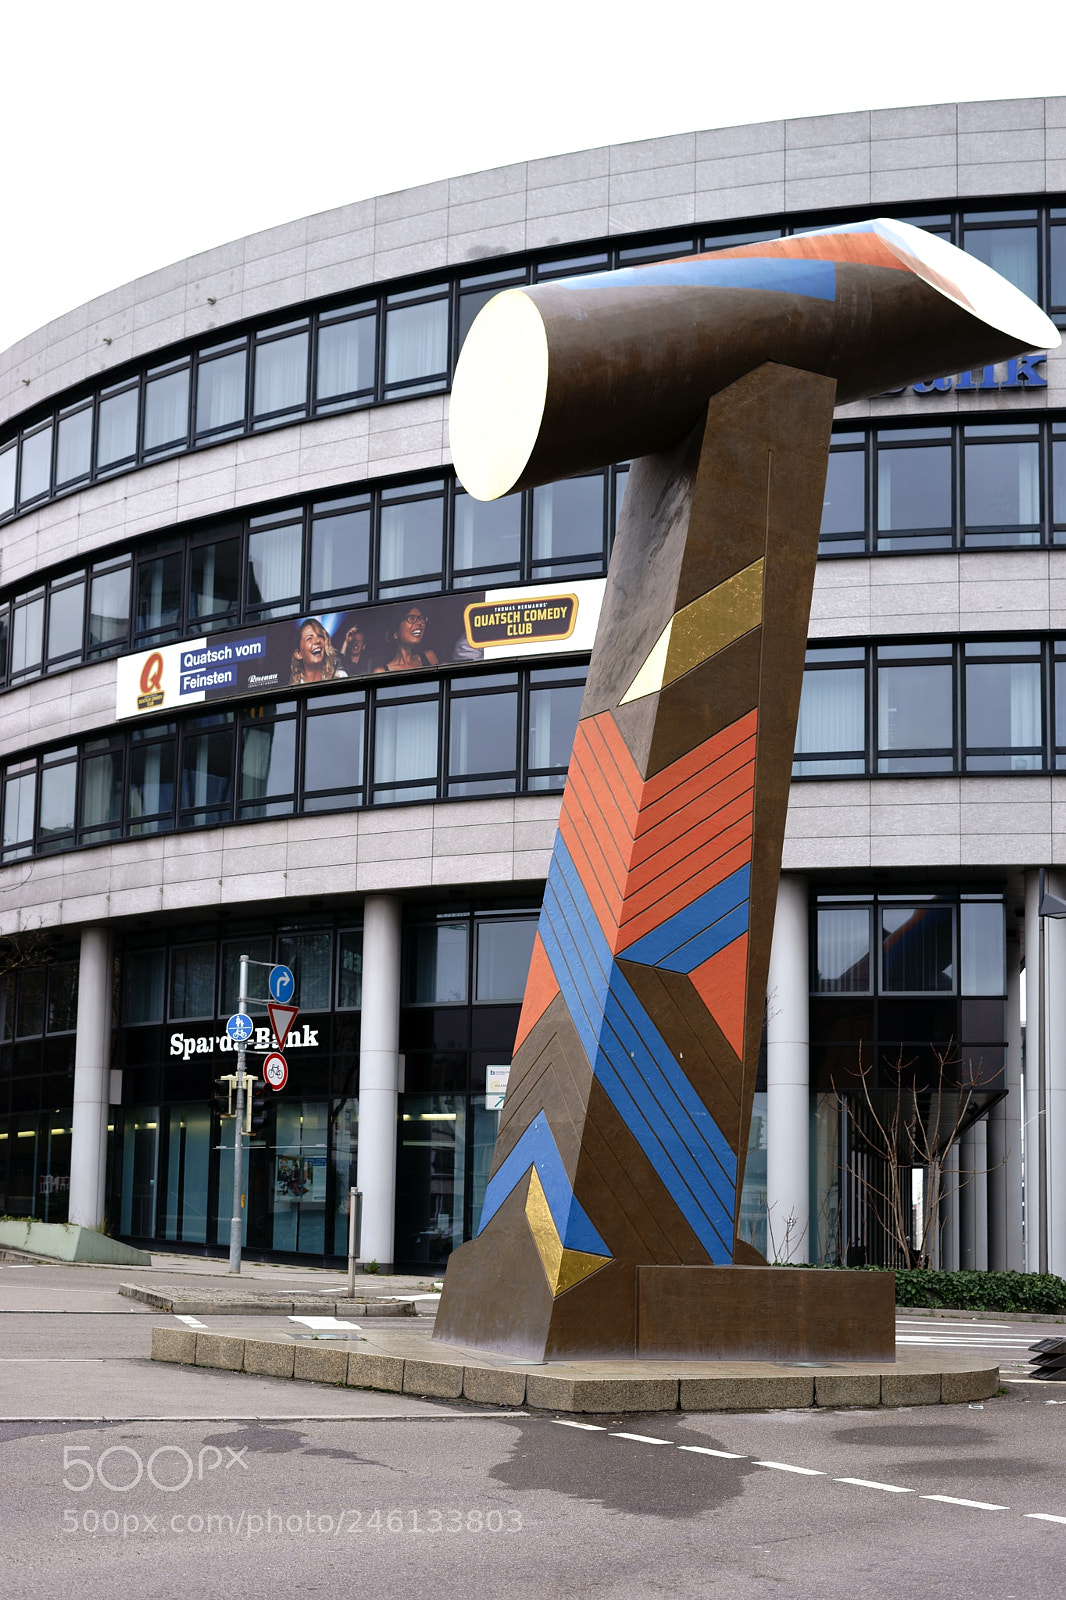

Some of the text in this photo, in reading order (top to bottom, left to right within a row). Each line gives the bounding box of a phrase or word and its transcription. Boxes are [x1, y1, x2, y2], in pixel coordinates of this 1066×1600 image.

[474, 606, 568, 628] QUATSCH COMEDY
[507, 623, 533, 636] CLUB
[184, 642, 262, 668] Quatsch vom
[183, 670, 232, 691] Feinsten
